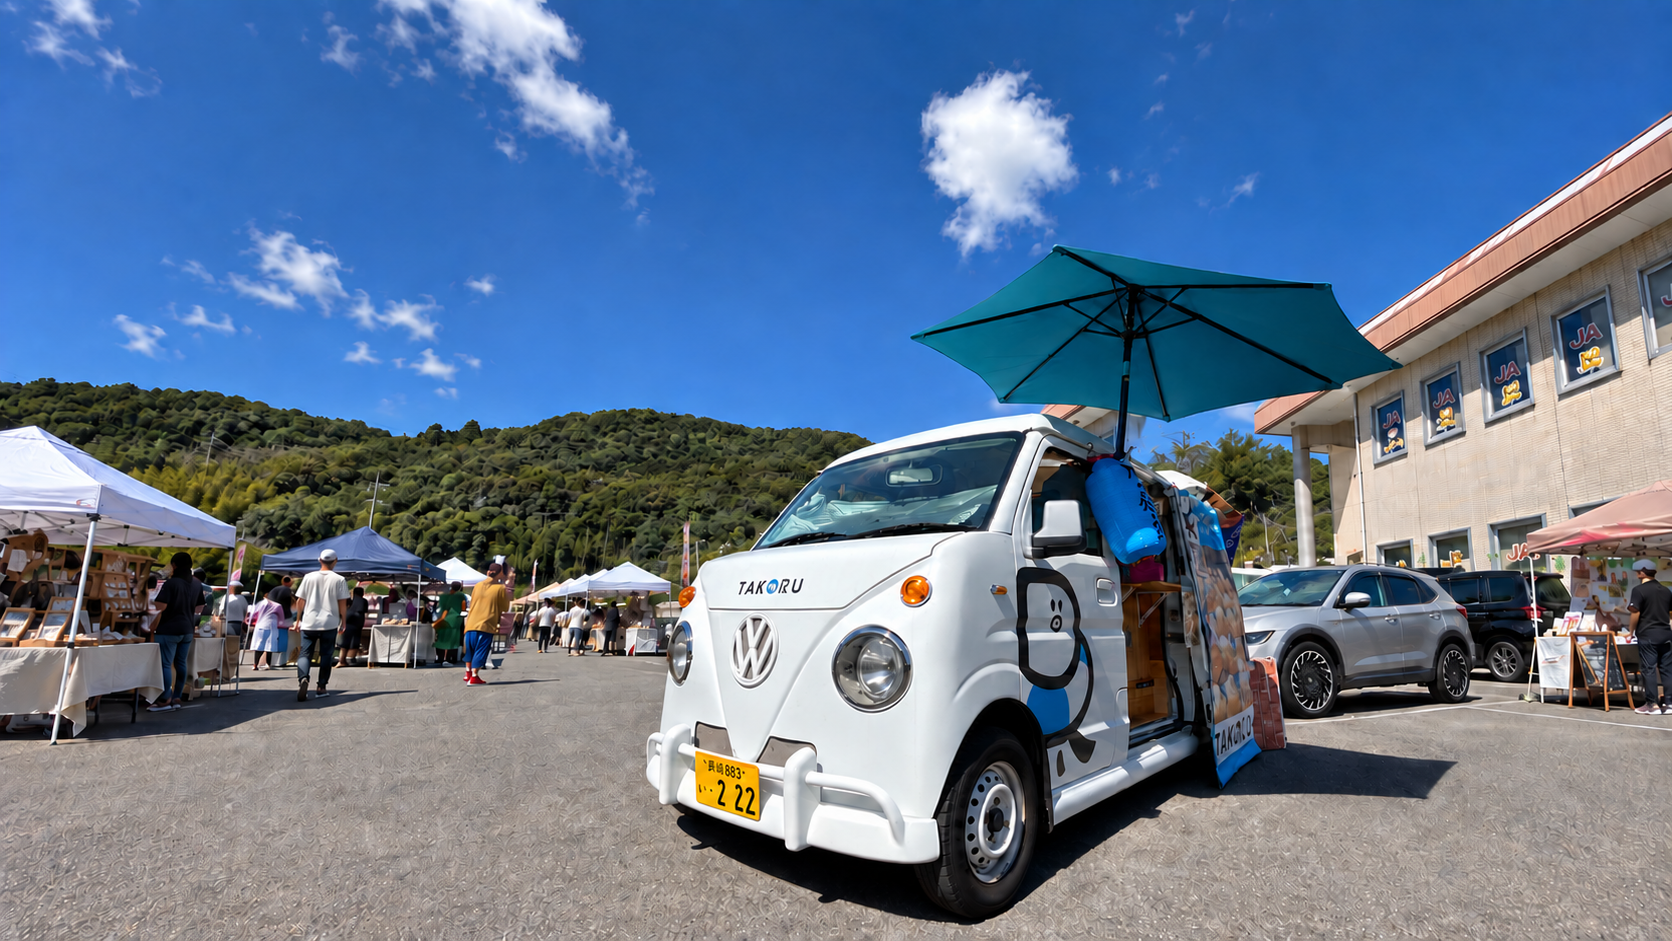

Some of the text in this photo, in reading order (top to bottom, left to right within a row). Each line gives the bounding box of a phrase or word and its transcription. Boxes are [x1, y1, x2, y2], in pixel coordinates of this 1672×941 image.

[1569, 322, 1603, 349] JA
[1494, 361, 1521, 384] JA
[1433, 388, 1455, 409] JA
[1383, 410, 1401, 429] JA
[738, 578, 804, 595] TAKORU
[733, 615, 776, 683] VW
